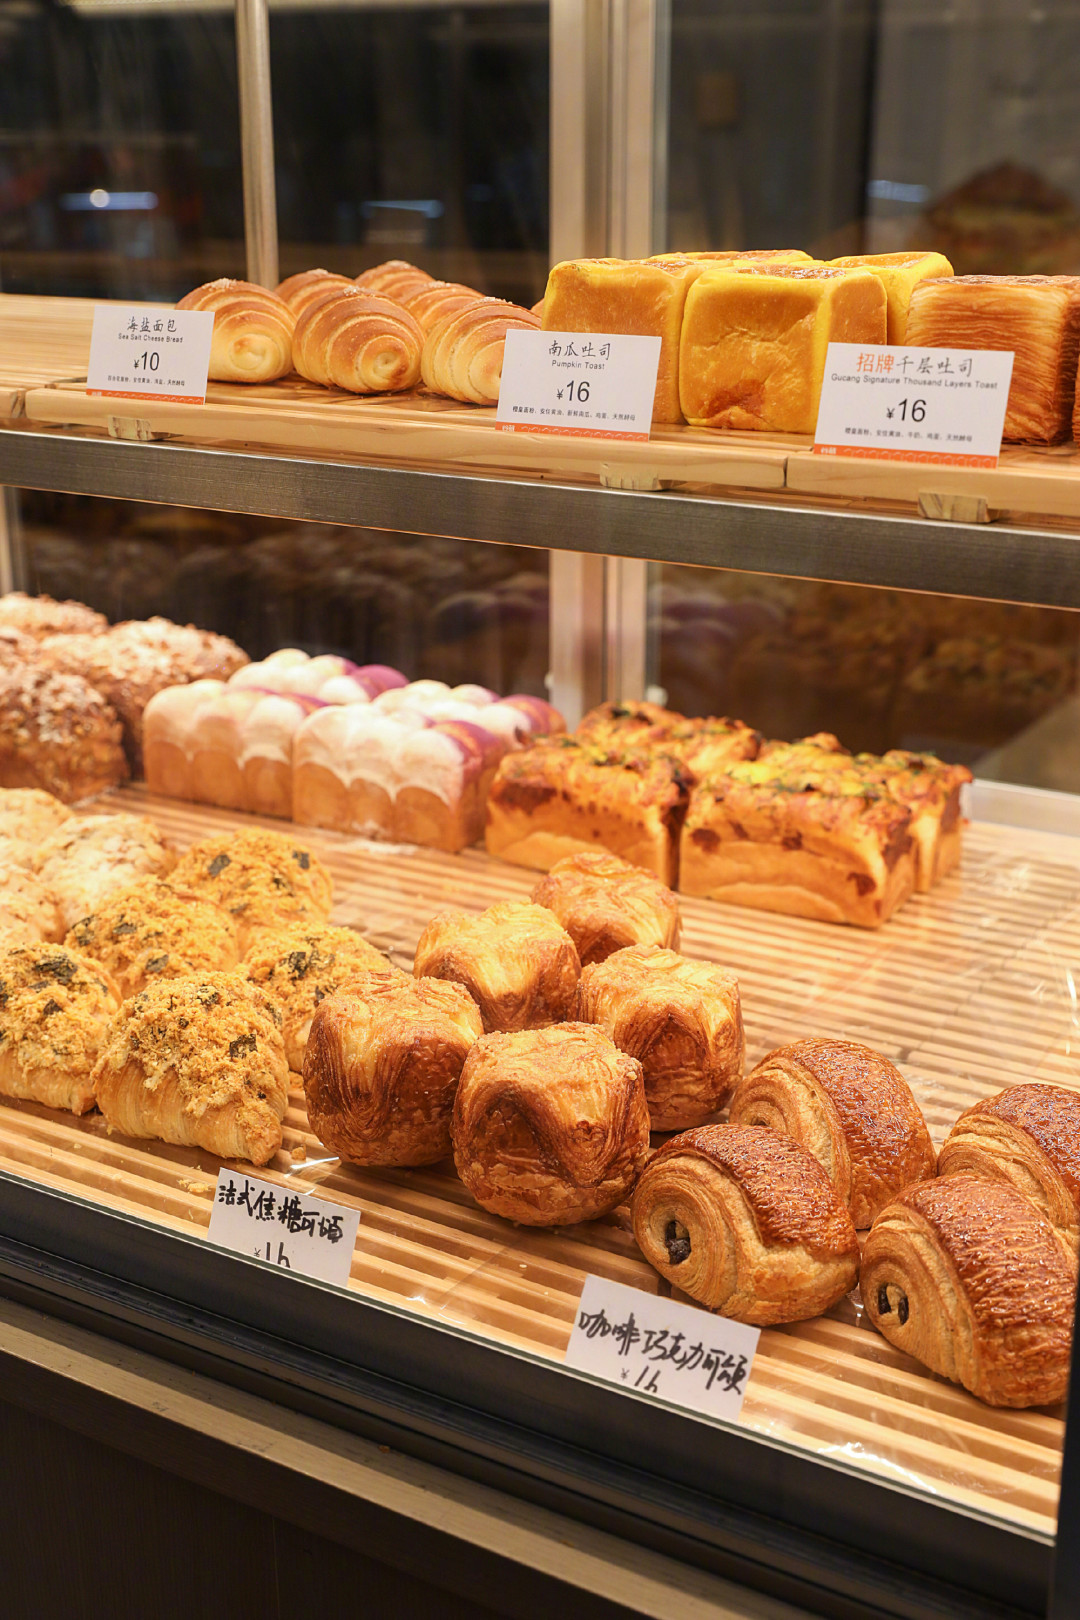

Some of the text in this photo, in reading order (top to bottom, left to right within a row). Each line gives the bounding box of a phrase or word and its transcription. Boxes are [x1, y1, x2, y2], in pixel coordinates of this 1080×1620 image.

[127, 316, 177, 333] 海盐面包
[143, 334, 164, 342] Cheese
[548, 340, 611, 361] 南瓜吐司
[133, 351, 160, 371] ¥10
[552, 360, 605, 370] Pumpkin Toast
[856, 353, 973, 377] 招牌千层吐司
[556, 380, 590, 403] ¥16
[831, 373, 998, 390] Gucang Signature Thousand Layers Toast
[886, 398, 927, 423] ¥16
